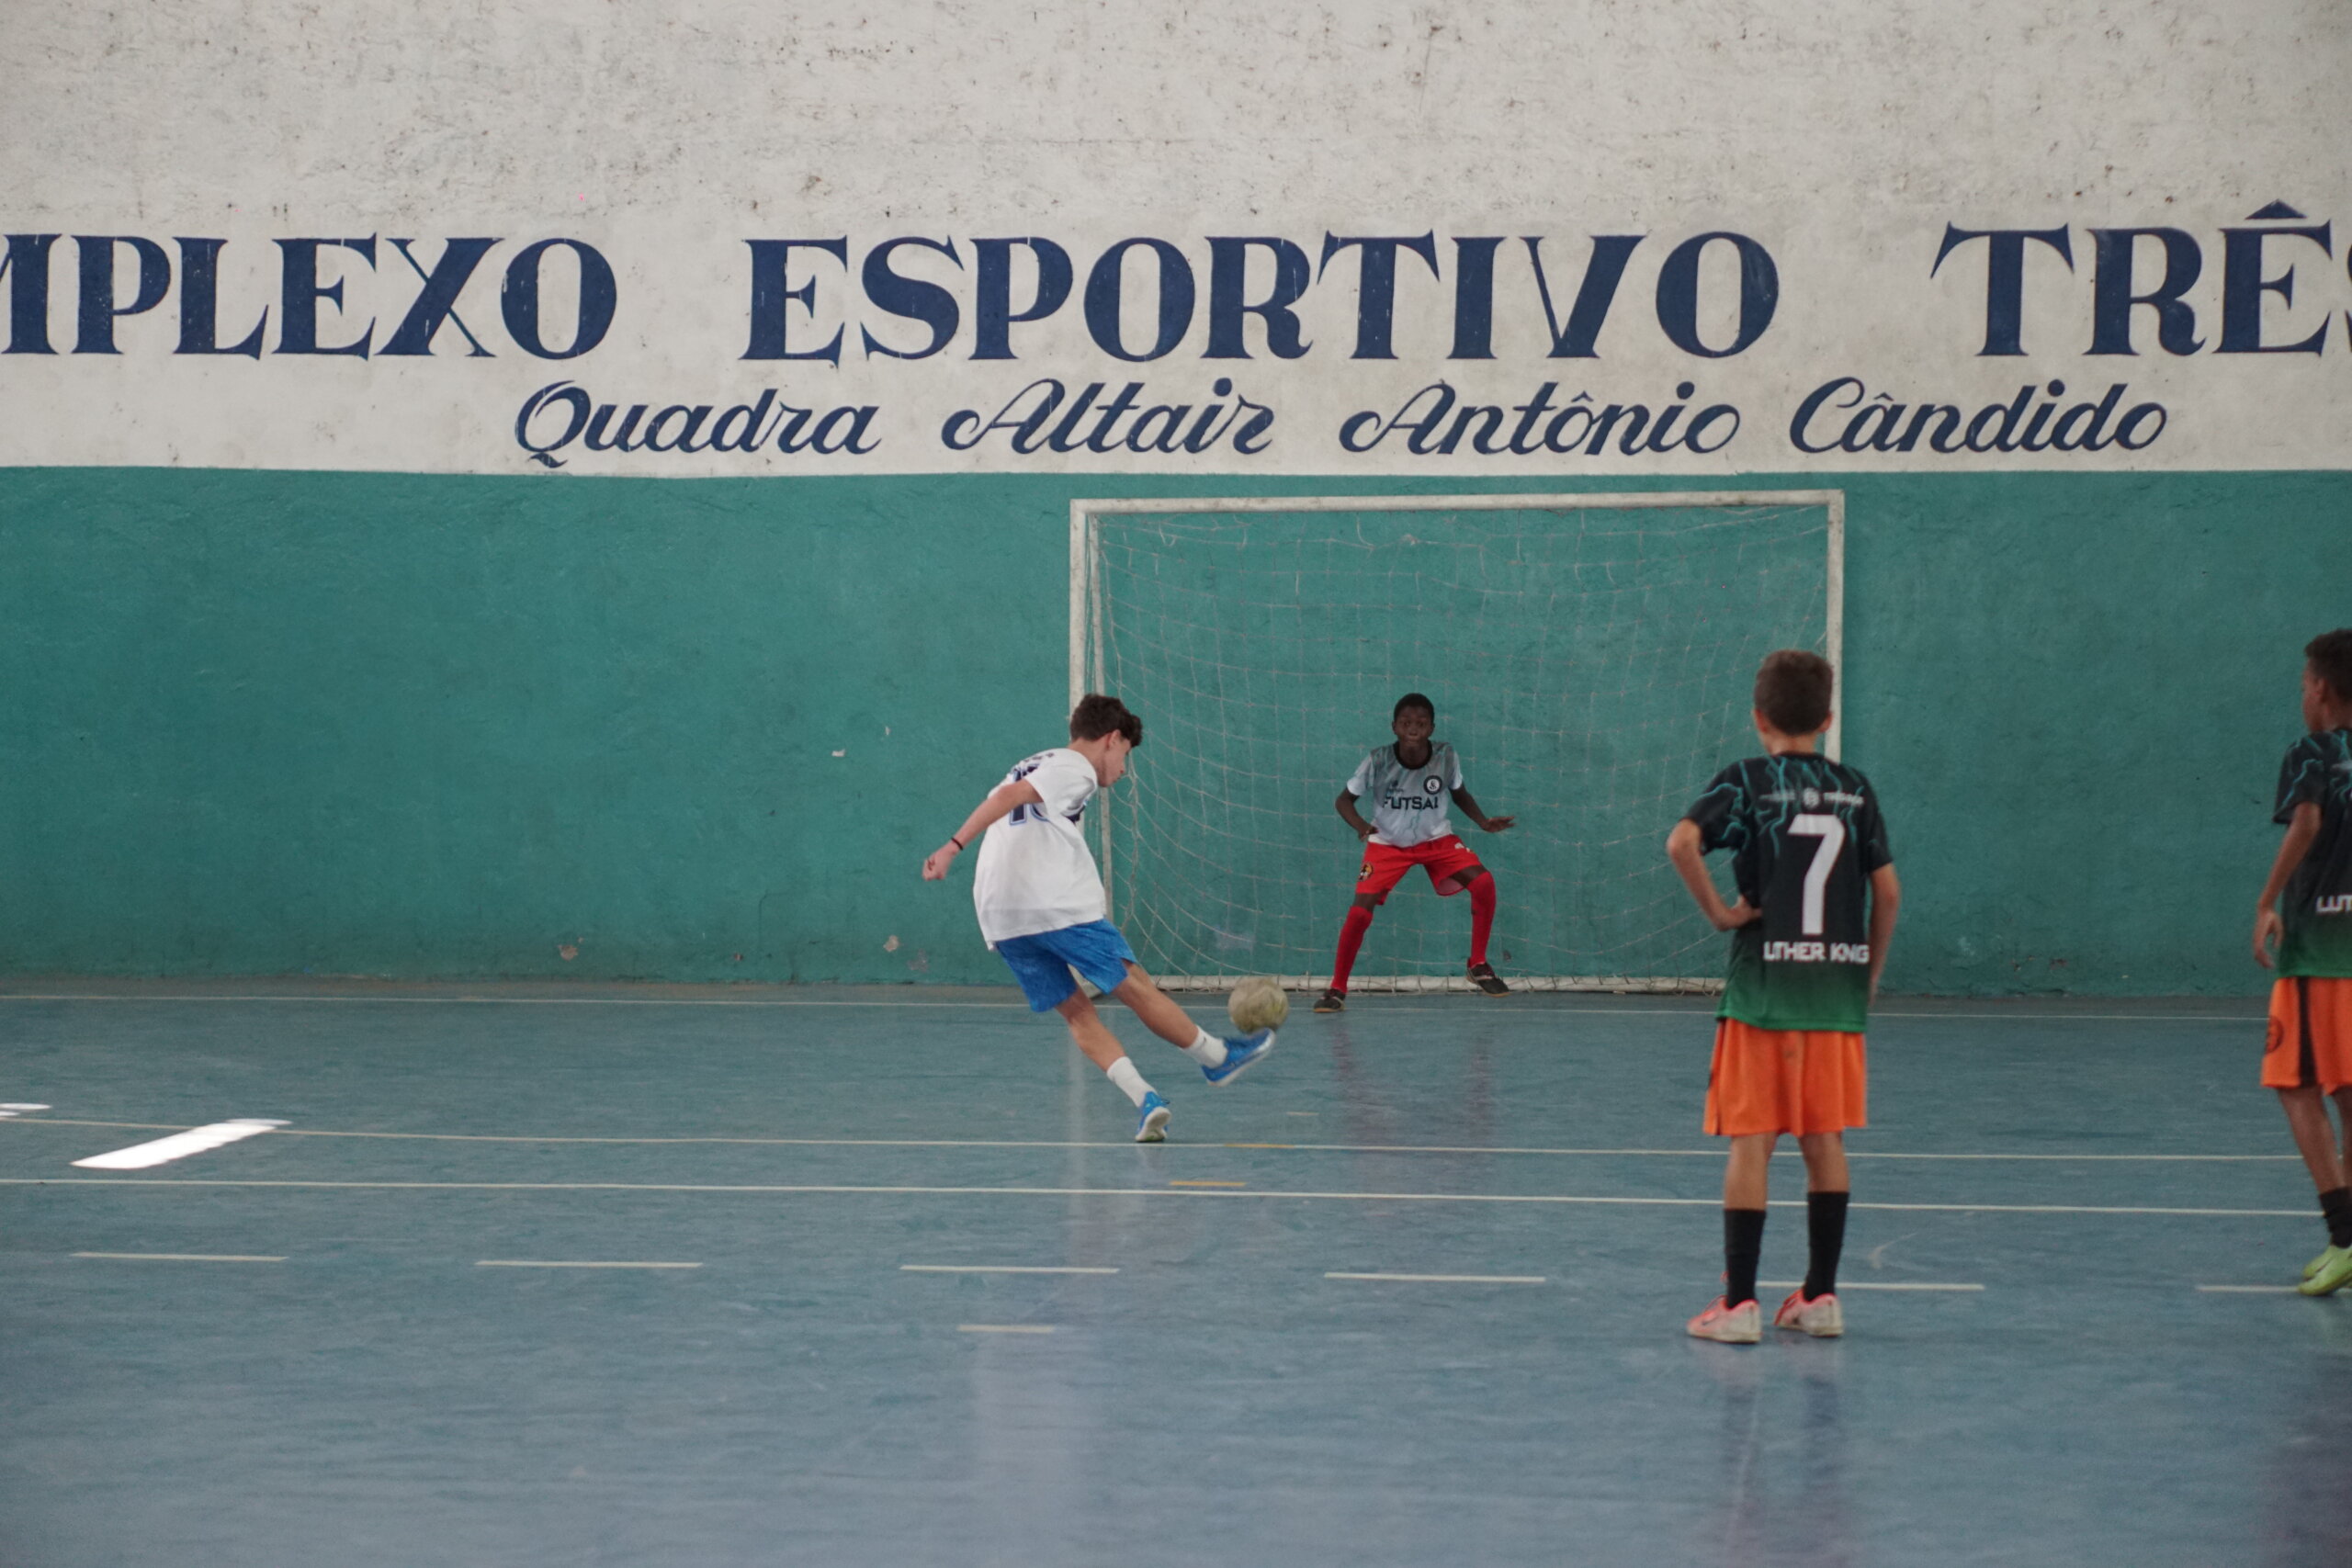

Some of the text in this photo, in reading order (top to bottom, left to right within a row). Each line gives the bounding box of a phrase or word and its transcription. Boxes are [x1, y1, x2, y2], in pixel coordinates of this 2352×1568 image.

[737, 230, 1780, 367] ESPORTIVO
[1930, 199, 2352, 358] TRÊ
[514, 376, 2168, 468] Quadra Altair Antônio Cândido
[1787, 814, 1845, 935] 7
[1829, 942, 1870, 964] KNG
